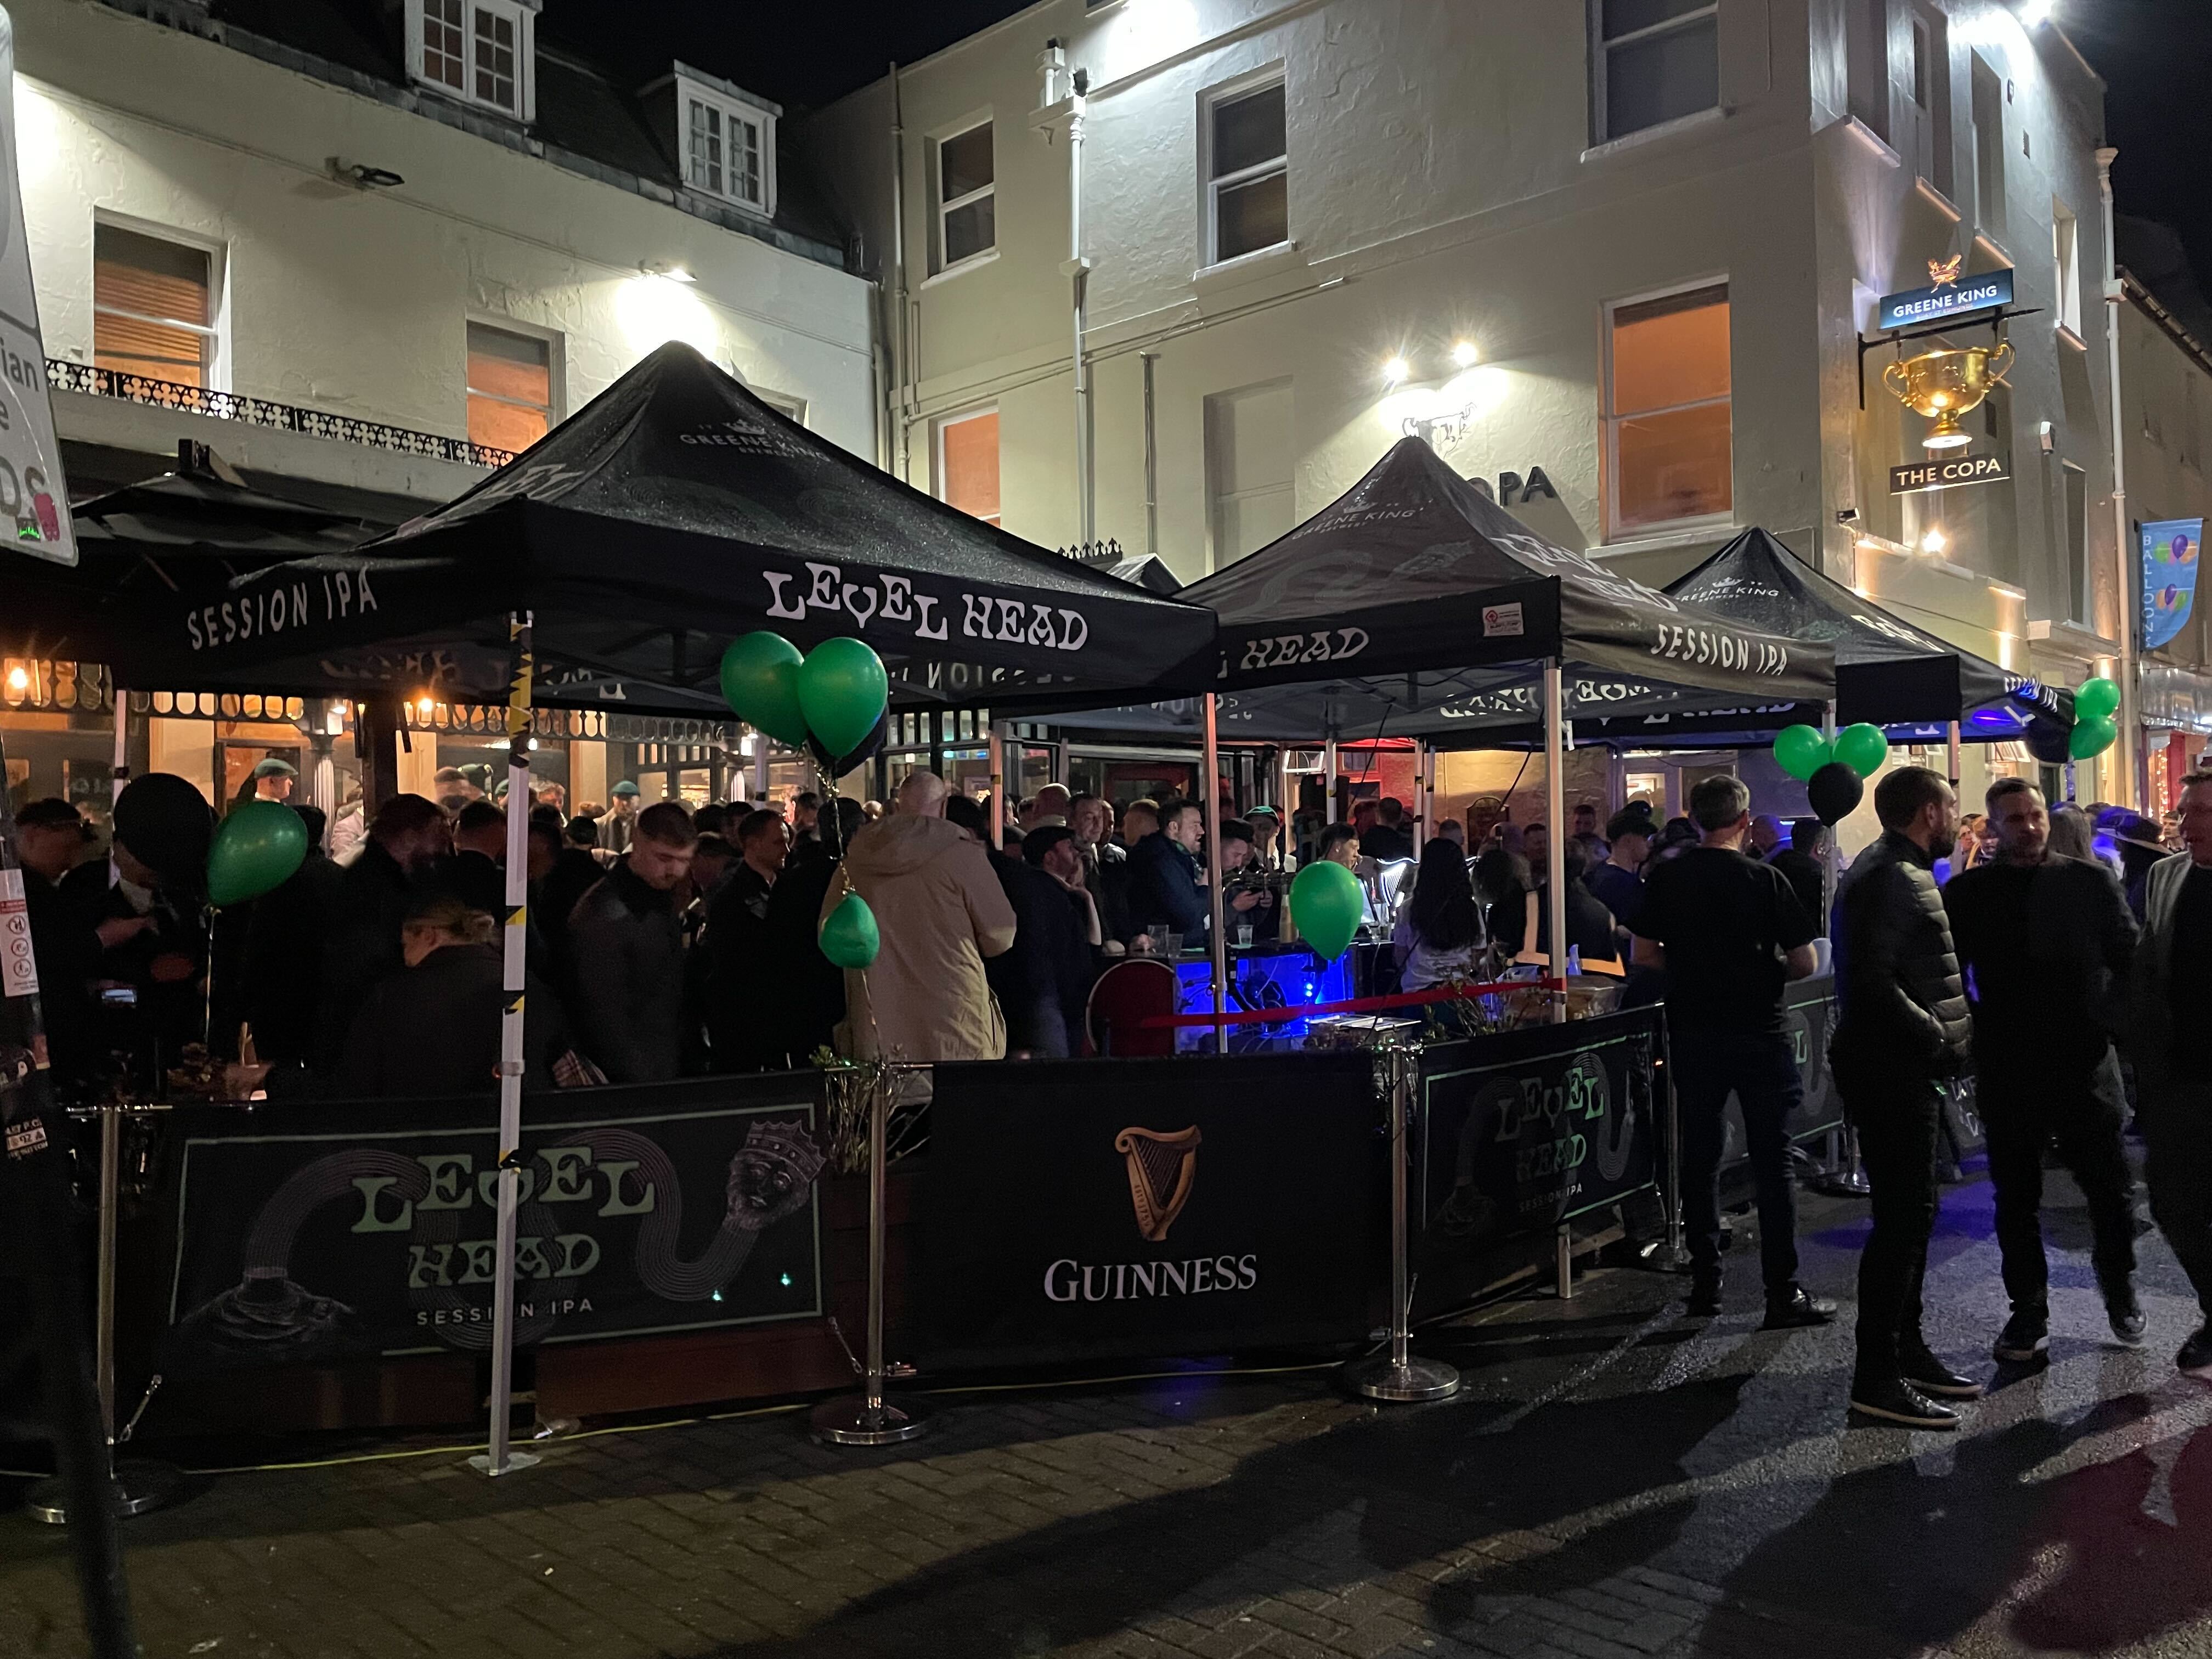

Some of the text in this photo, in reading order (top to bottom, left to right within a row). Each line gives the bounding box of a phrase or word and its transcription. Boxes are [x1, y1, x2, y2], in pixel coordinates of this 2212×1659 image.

[1893, 285, 1997, 318] GREENE KING
[1896, 458, 2001, 486] THE COPA
[1364, 510, 1416, 521] KING
[187, 562, 378, 650] SESSION IPA
[762, 561, 1090, 652] LEVEL HEAD
[1675, 586, 1780, 602] REENE KING
[1240, 627, 1370, 670] HEAD
[1650, 624, 1788, 676] SESSION IPA
[1494, 1066, 1605, 1142] LEVEL
[351, 1146, 656, 1234] LEVEL
[1566, 1182, 1583, 1197] IPA
[408, 1233, 602, 1289] HEAD
[1044, 1254, 1257, 1302] GUINNESS
[417, 1298, 594, 1326] SESSIN IPA
